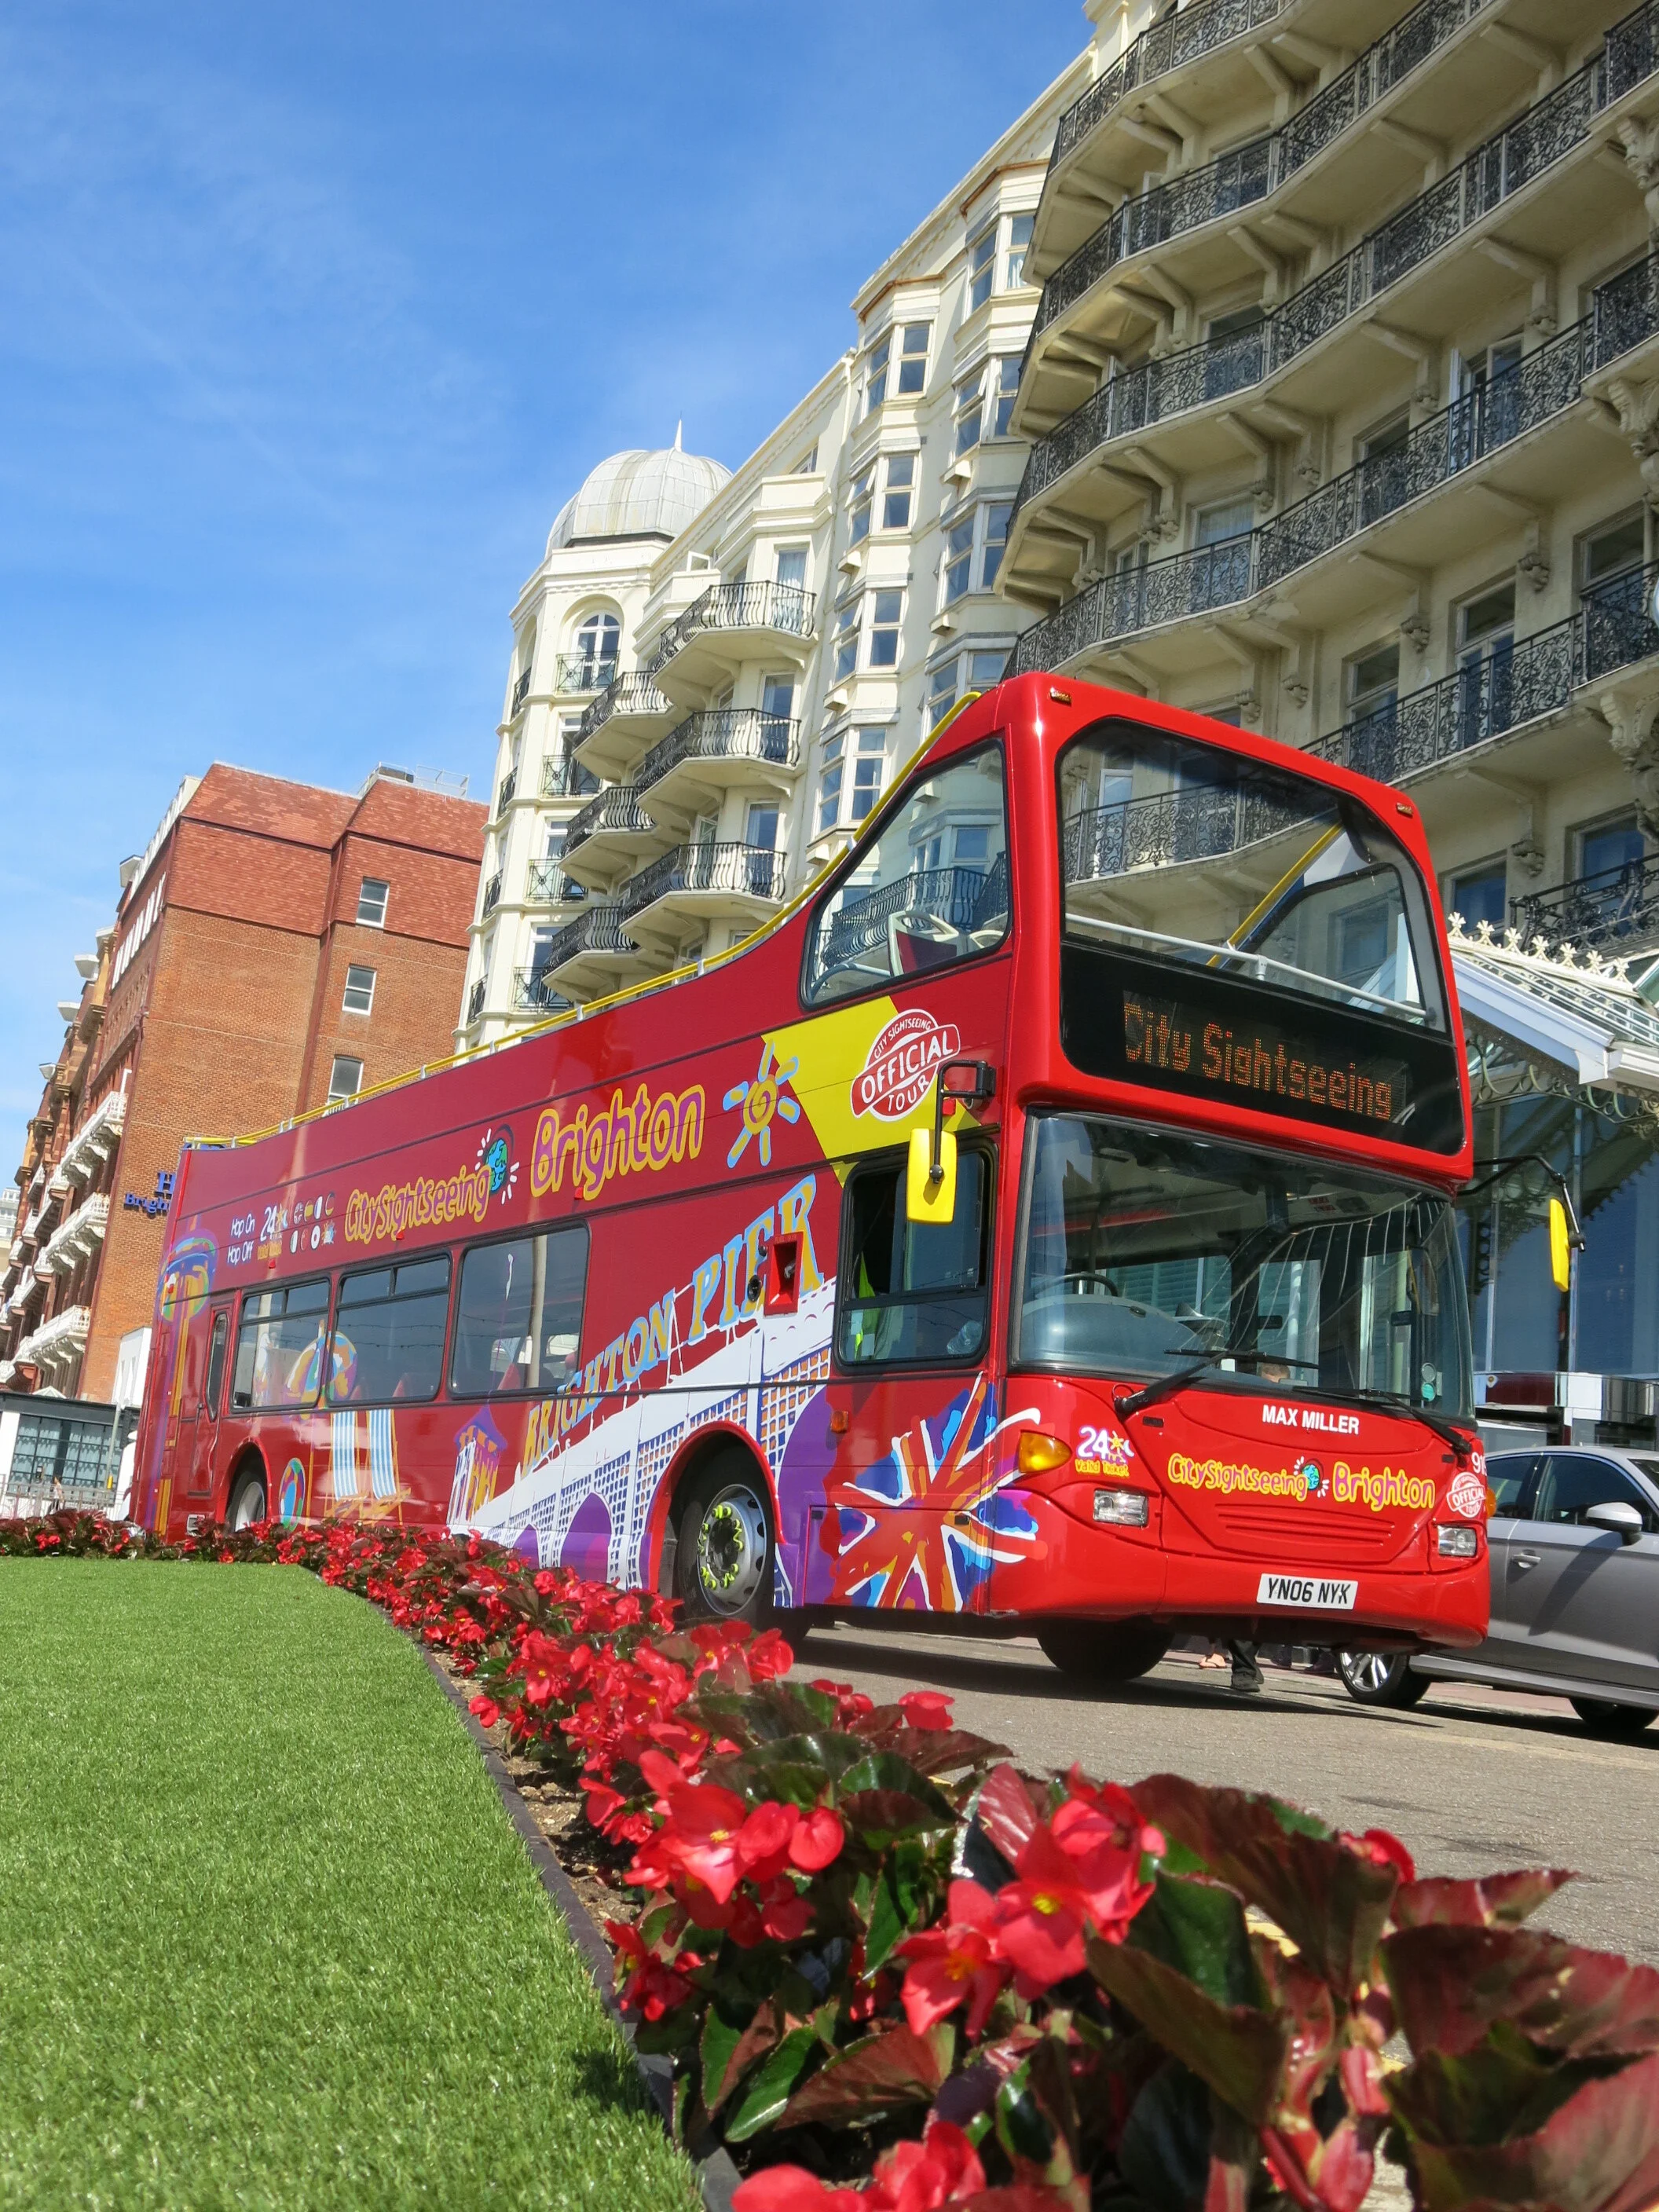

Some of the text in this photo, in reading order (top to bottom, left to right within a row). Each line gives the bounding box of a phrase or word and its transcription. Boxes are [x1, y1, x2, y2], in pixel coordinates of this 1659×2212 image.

[873, 1017, 931, 1059] CITY SIGHTSEEING
[861, 1031, 953, 1104] OFFICIAL
[1124, 1002, 1392, 1121] City Sightseeing
[888, 1074, 930, 1111] TOUR
[530, 1083, 705, 1201] Brighton
[124, 1192, 170, 1216] Brigh
[230, 1213, 255, 1238] Hop On
[227, 1245, 241, 1265] Hop
[242, 1240, 255, 1262] Off
[522, 1174, 825, 1475] BRIGHTON PIER
[1262, 1404, 1360, 1435] MAX MILLER
[1075, 1459, 1100, 1474] Valid
[1332, 1461, 1436, 1512] Brighton
[1268, 1577, 1351, 1605] YN06 NYK
